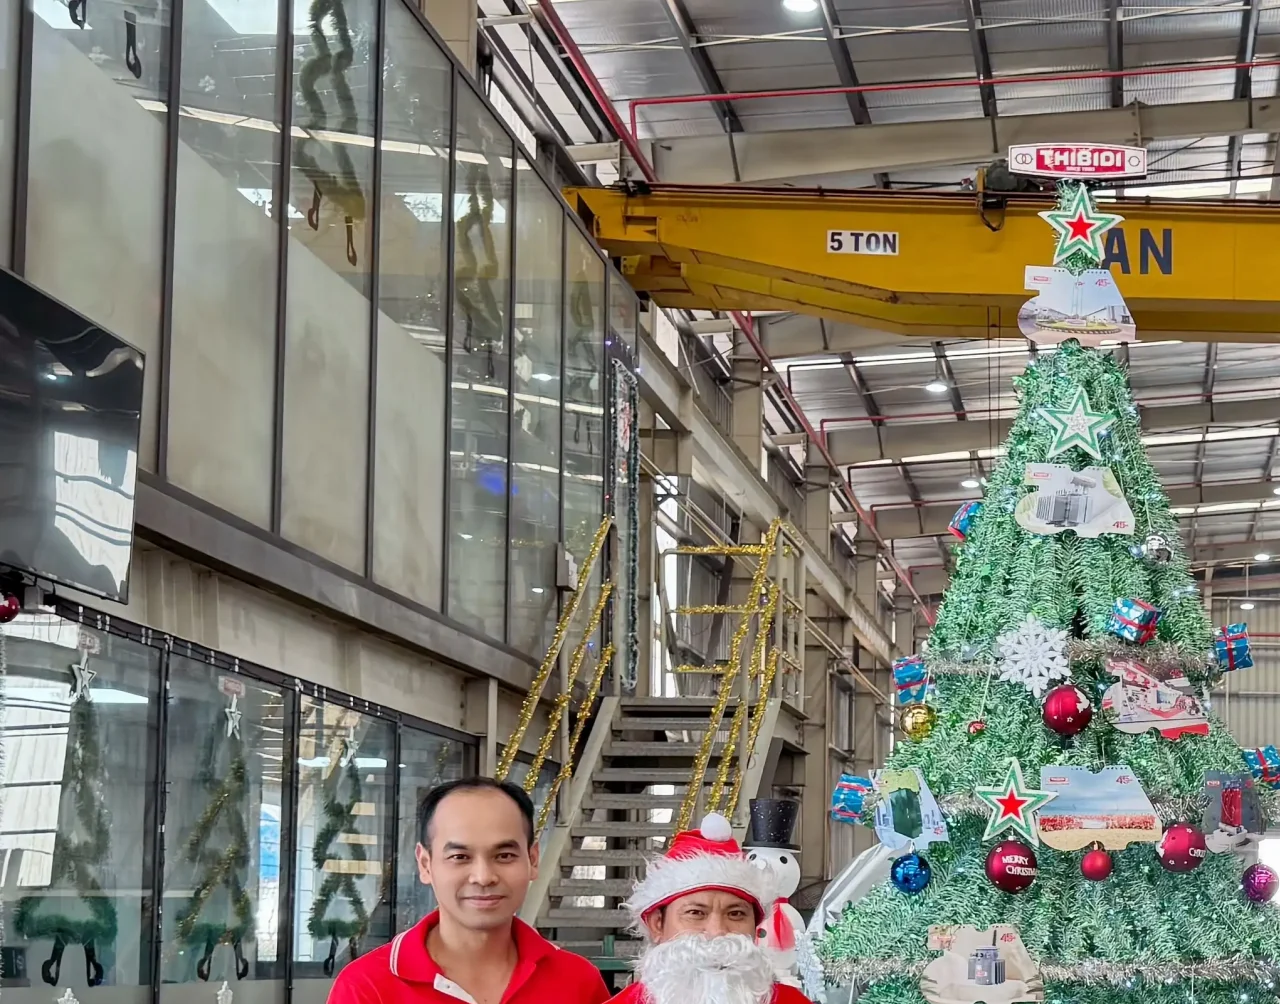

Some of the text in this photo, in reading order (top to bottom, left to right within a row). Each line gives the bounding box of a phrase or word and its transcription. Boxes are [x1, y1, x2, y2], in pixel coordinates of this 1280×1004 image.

[1039, 149, 1123, 167] THIBIDI
[830, 231, 897, 253] 5 TON
[1002, 855, 1029, 865] MERRY
